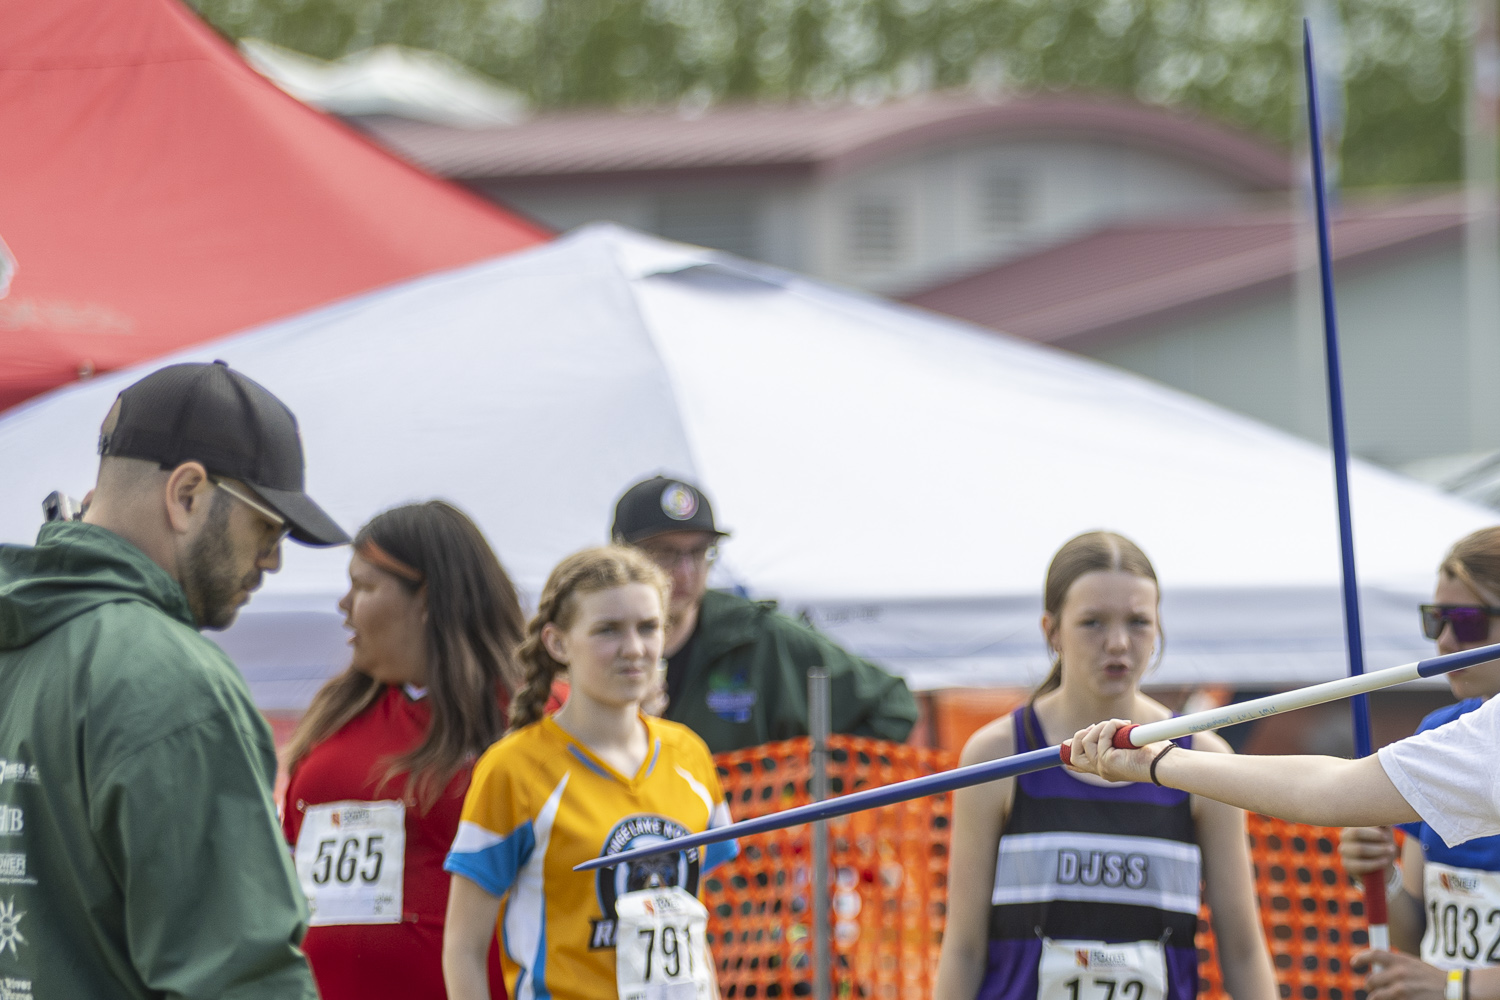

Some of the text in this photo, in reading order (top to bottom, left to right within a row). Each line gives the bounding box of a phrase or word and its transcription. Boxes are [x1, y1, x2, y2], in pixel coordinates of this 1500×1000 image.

[628, 818, 661, 836] LAKE
[313, 835, 384, 884] 565
[1057, 849, 1148, 889] DJSS
[638, 924, 694, 982] 791
